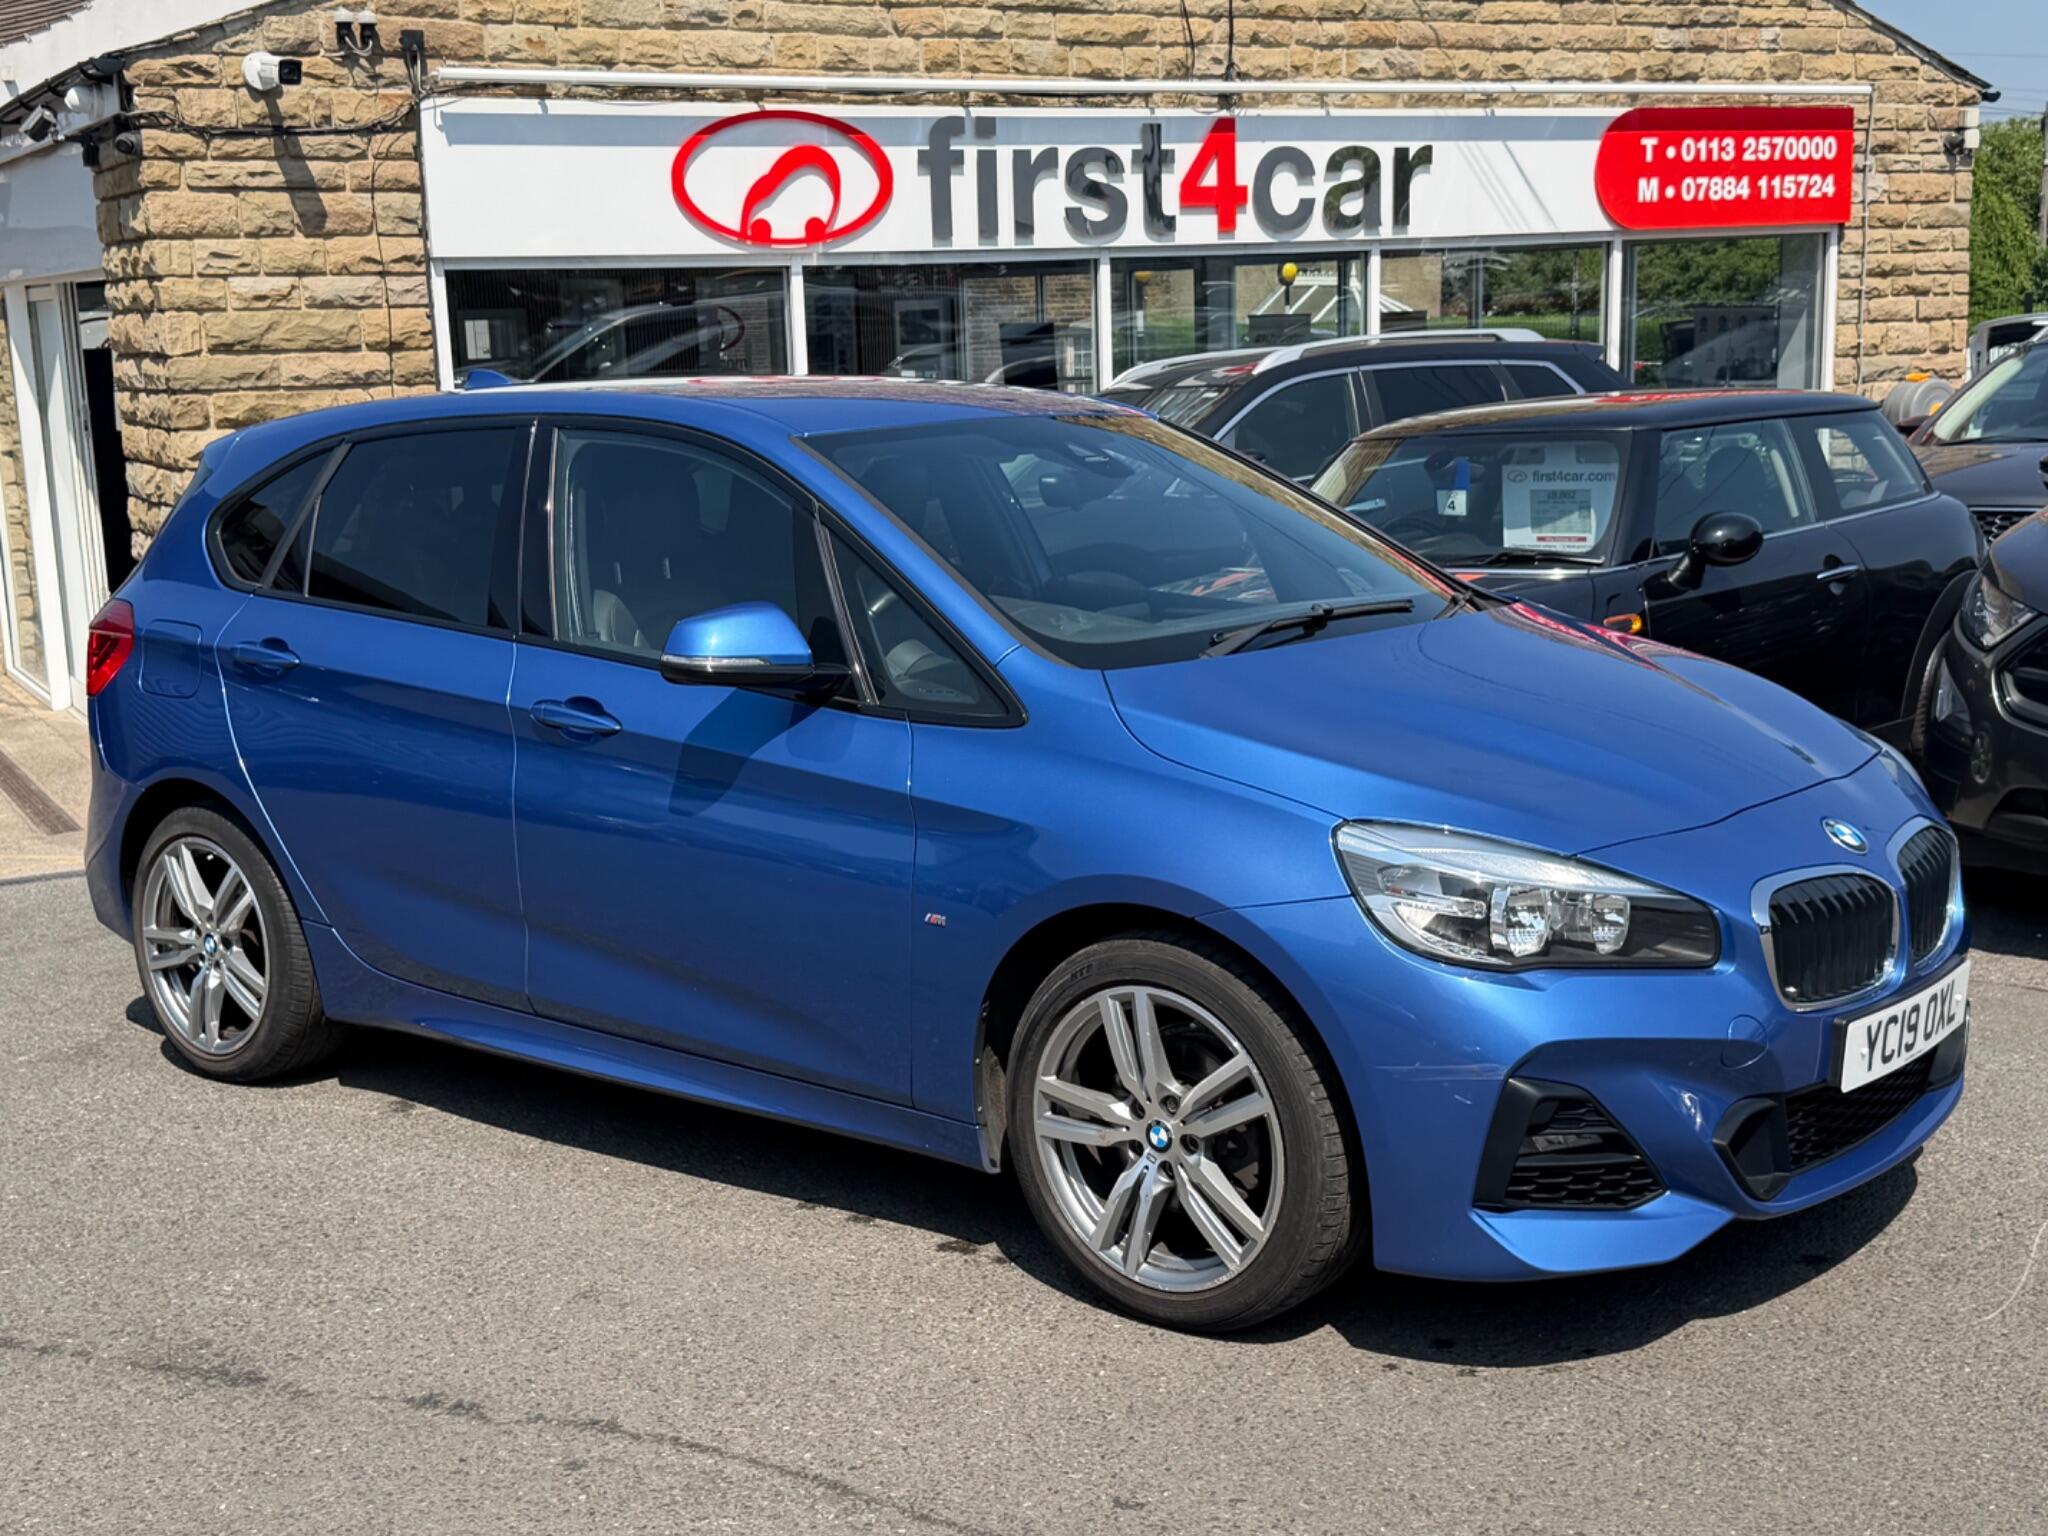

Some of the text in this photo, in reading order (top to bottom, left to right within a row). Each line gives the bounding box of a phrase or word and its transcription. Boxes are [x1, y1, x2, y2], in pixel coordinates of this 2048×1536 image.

[1640, 136, 1837, 162] T 0113 2570000
[918, 116, 1433, 246] first4car
[1637, 174, 1835, 202] M 07884 115724
[1532, 470, 1616, 482] first4car.com
[1448, 499, 1456, 511] 4
[1867, 979, 1956, 1073] YC19 OXL
